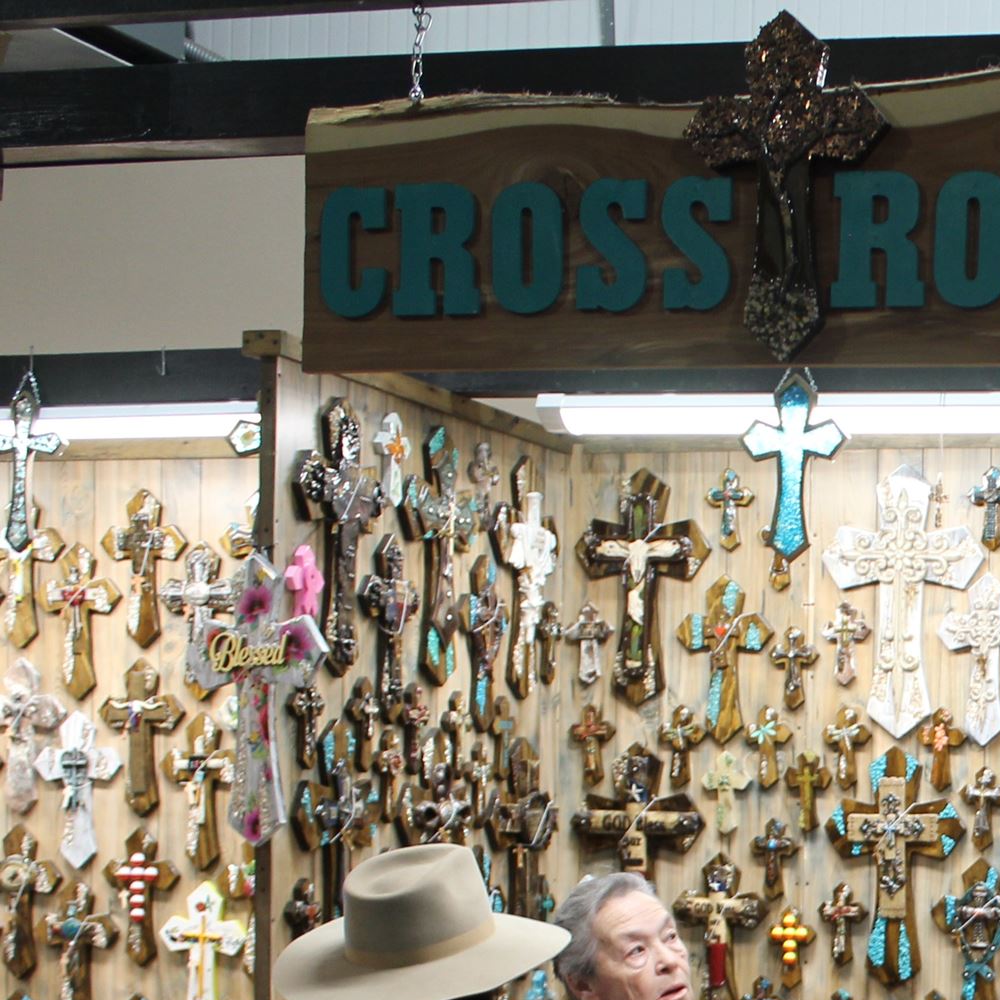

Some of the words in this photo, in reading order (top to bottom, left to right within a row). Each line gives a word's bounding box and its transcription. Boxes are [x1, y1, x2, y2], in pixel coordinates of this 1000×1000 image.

[320, 175, 733, 318] CROSS
[209, 629, 291, 673] Blessed
[602, 814, 630, 831] GOD
